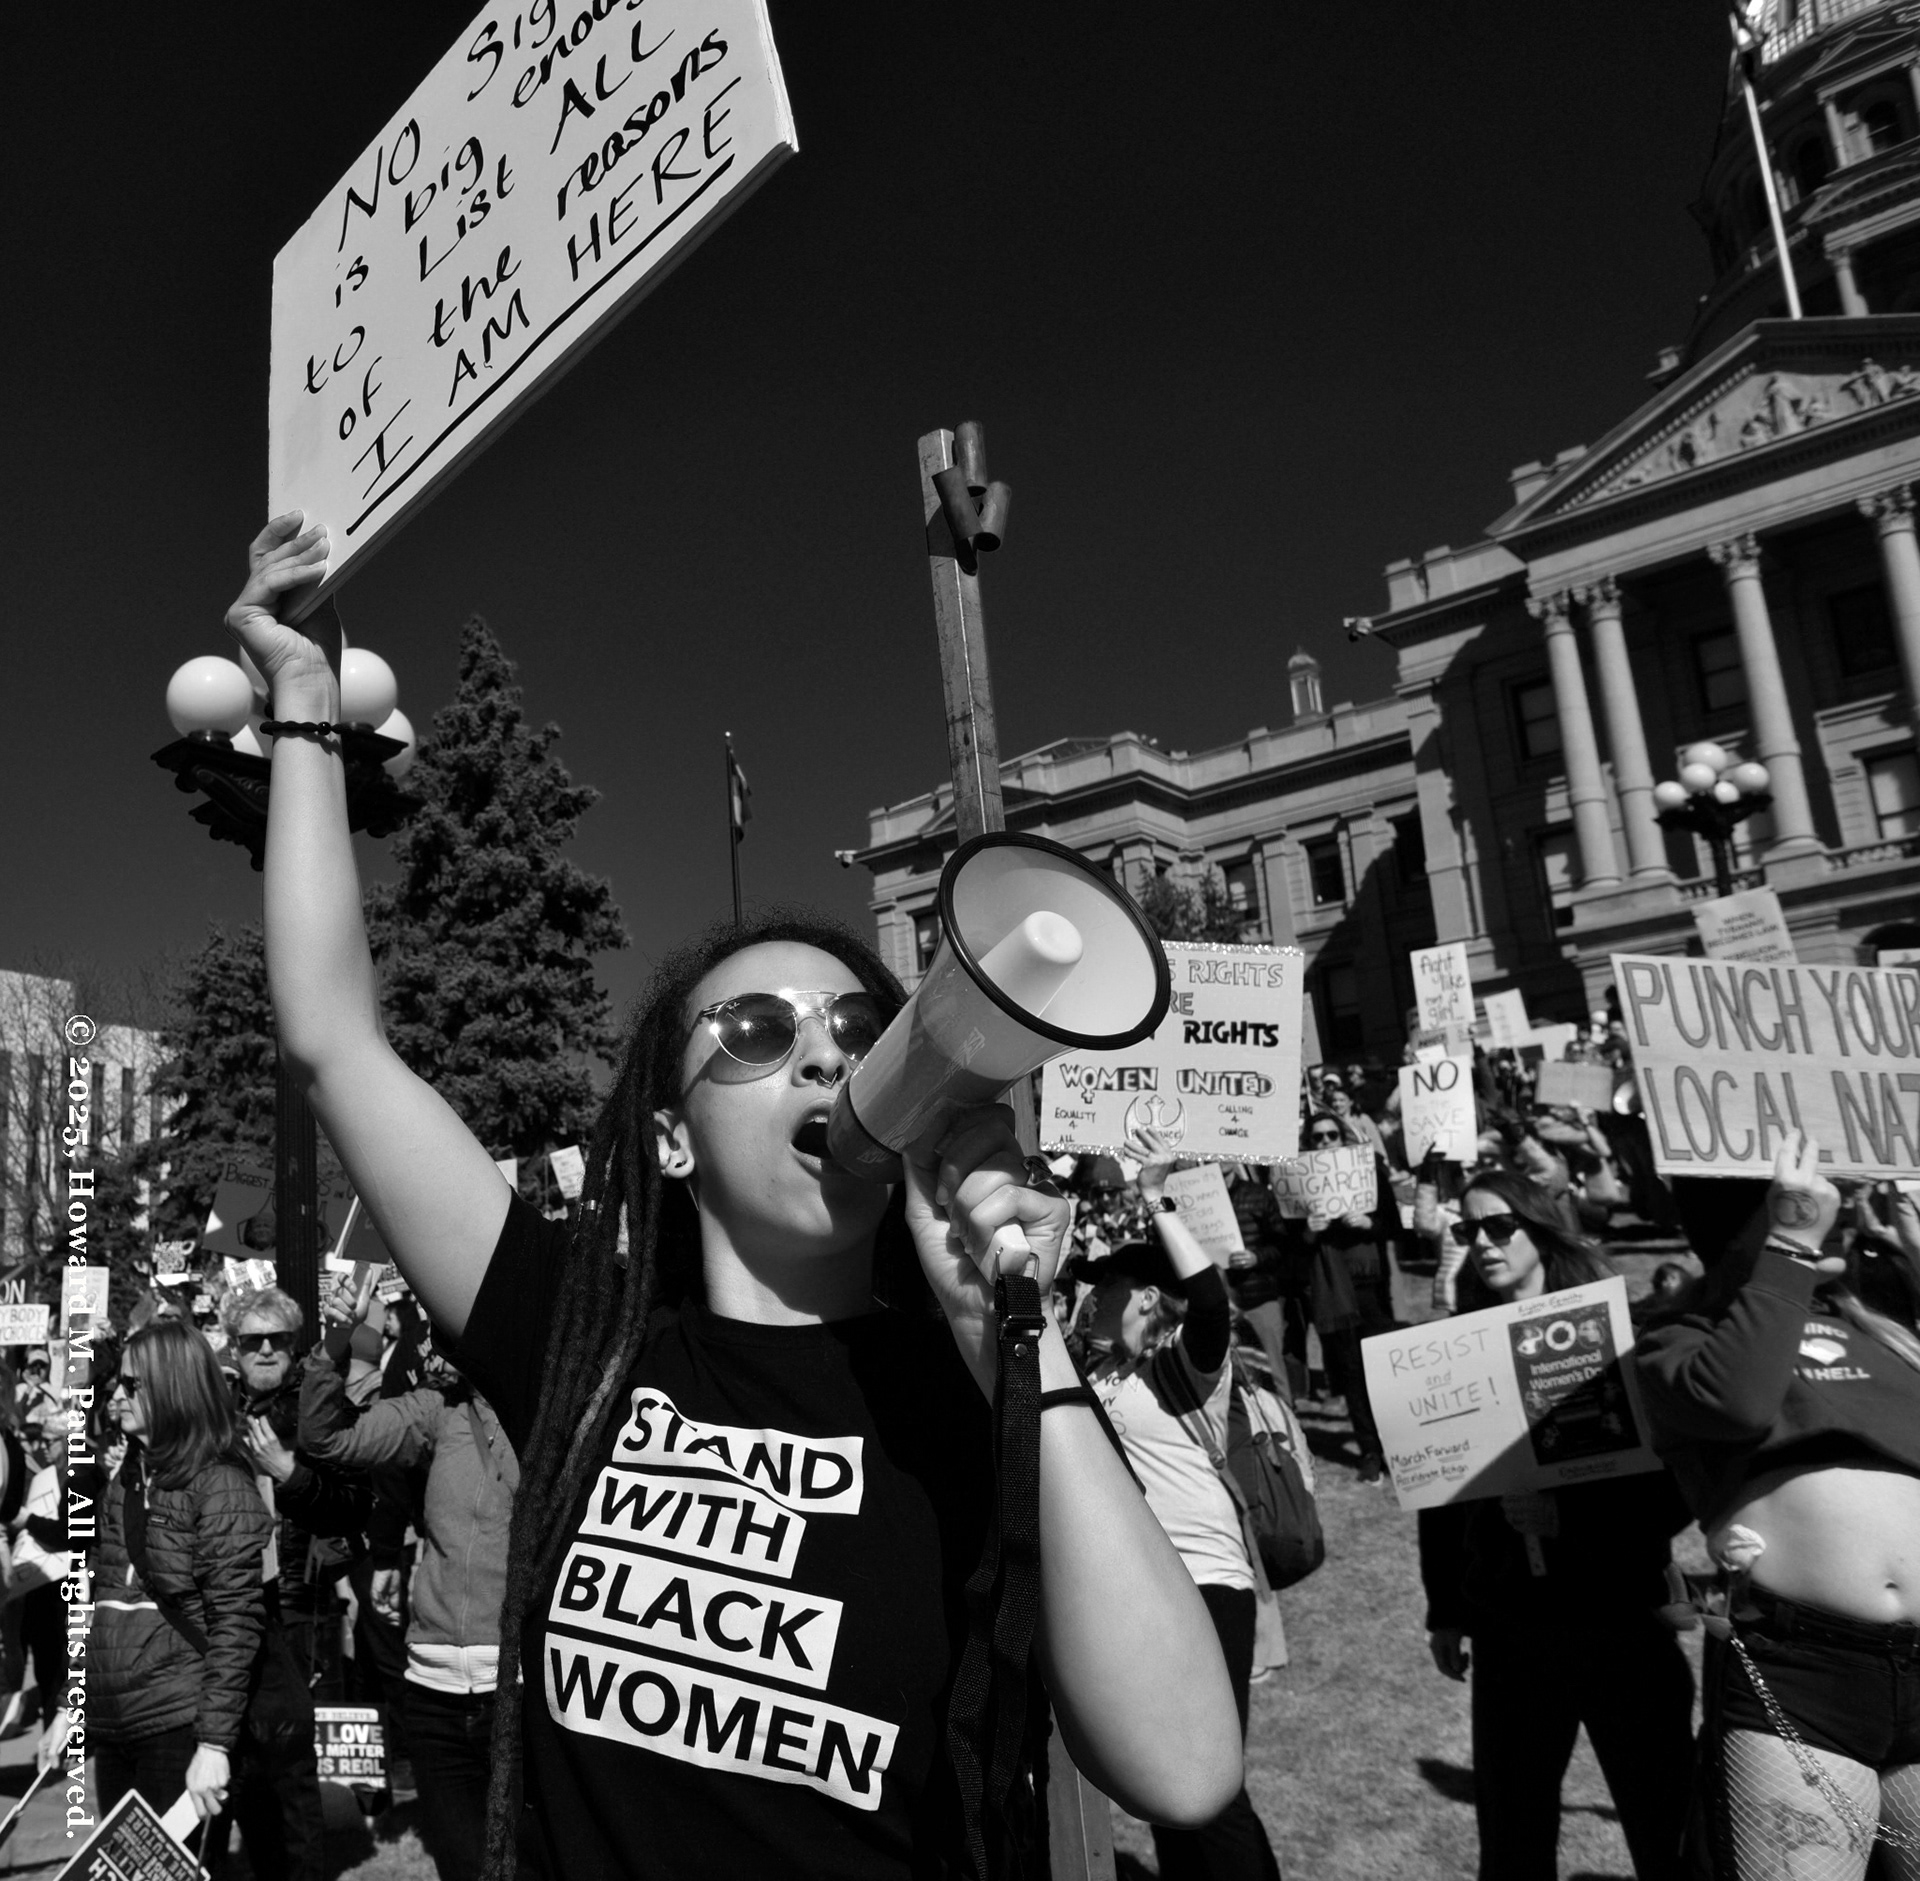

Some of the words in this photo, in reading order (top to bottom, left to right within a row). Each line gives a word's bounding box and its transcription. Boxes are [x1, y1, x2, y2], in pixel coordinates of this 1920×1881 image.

[302, 325, 365, 394] to
[419, 154, 515, 282] List
[549, 20, 675, 155] ALL
[338, 119, 420, 253] NO
[335, 255, 369, 309] is
[405, 137, 484, 234] big
[338, 356, 382, 441] of
[427, 245, 522, 349] the
[557, 28, 729, 221] reasons
[351, 399, 413, 499] I
[447, 288, 530, 408] AM
[566, 76, 742, 282] HERE
[1188, 959, 1284, 988] RIGHTS
[1621, 962, 1813, 1054] PUNCH
[1183, 1020, 1279, 1048] RIGHTS
[1059, 1063, 1159, 1101] WOMEN
[1176, 1068, 1276, 1098] UNITED
[1413, 1060, 1459, 1096] NO
[1055, 1107, 1096, 1123] EQUALITY
[1410, 1107, 1466, 1136] SAVE
[1643, 1065, 1833, 1162] LOCAL
[224, 1163, 270, 1188] BIGGEST
[1389, 1327, 1489, 1377] RESIST
[1530, 1348, 1603, 1376] International
[1529, 1369, 1584, 1391] Women's
[621, 1398, 854, 1500] STAND
[1391, 1450, 1426, 1470] March
[600, 1475, 791, 1563] WITH
[558, 1554, 825, 1672] BLACK
[327, 1723, 383, 1744] LOVE
[550, 1647, 882, 1795] WOMEN
[326, 1743, 385, 1758] MATTER
[339, 1757, 386, 1775] REAL
[124, 1810, 171, 1863] FUTURE
